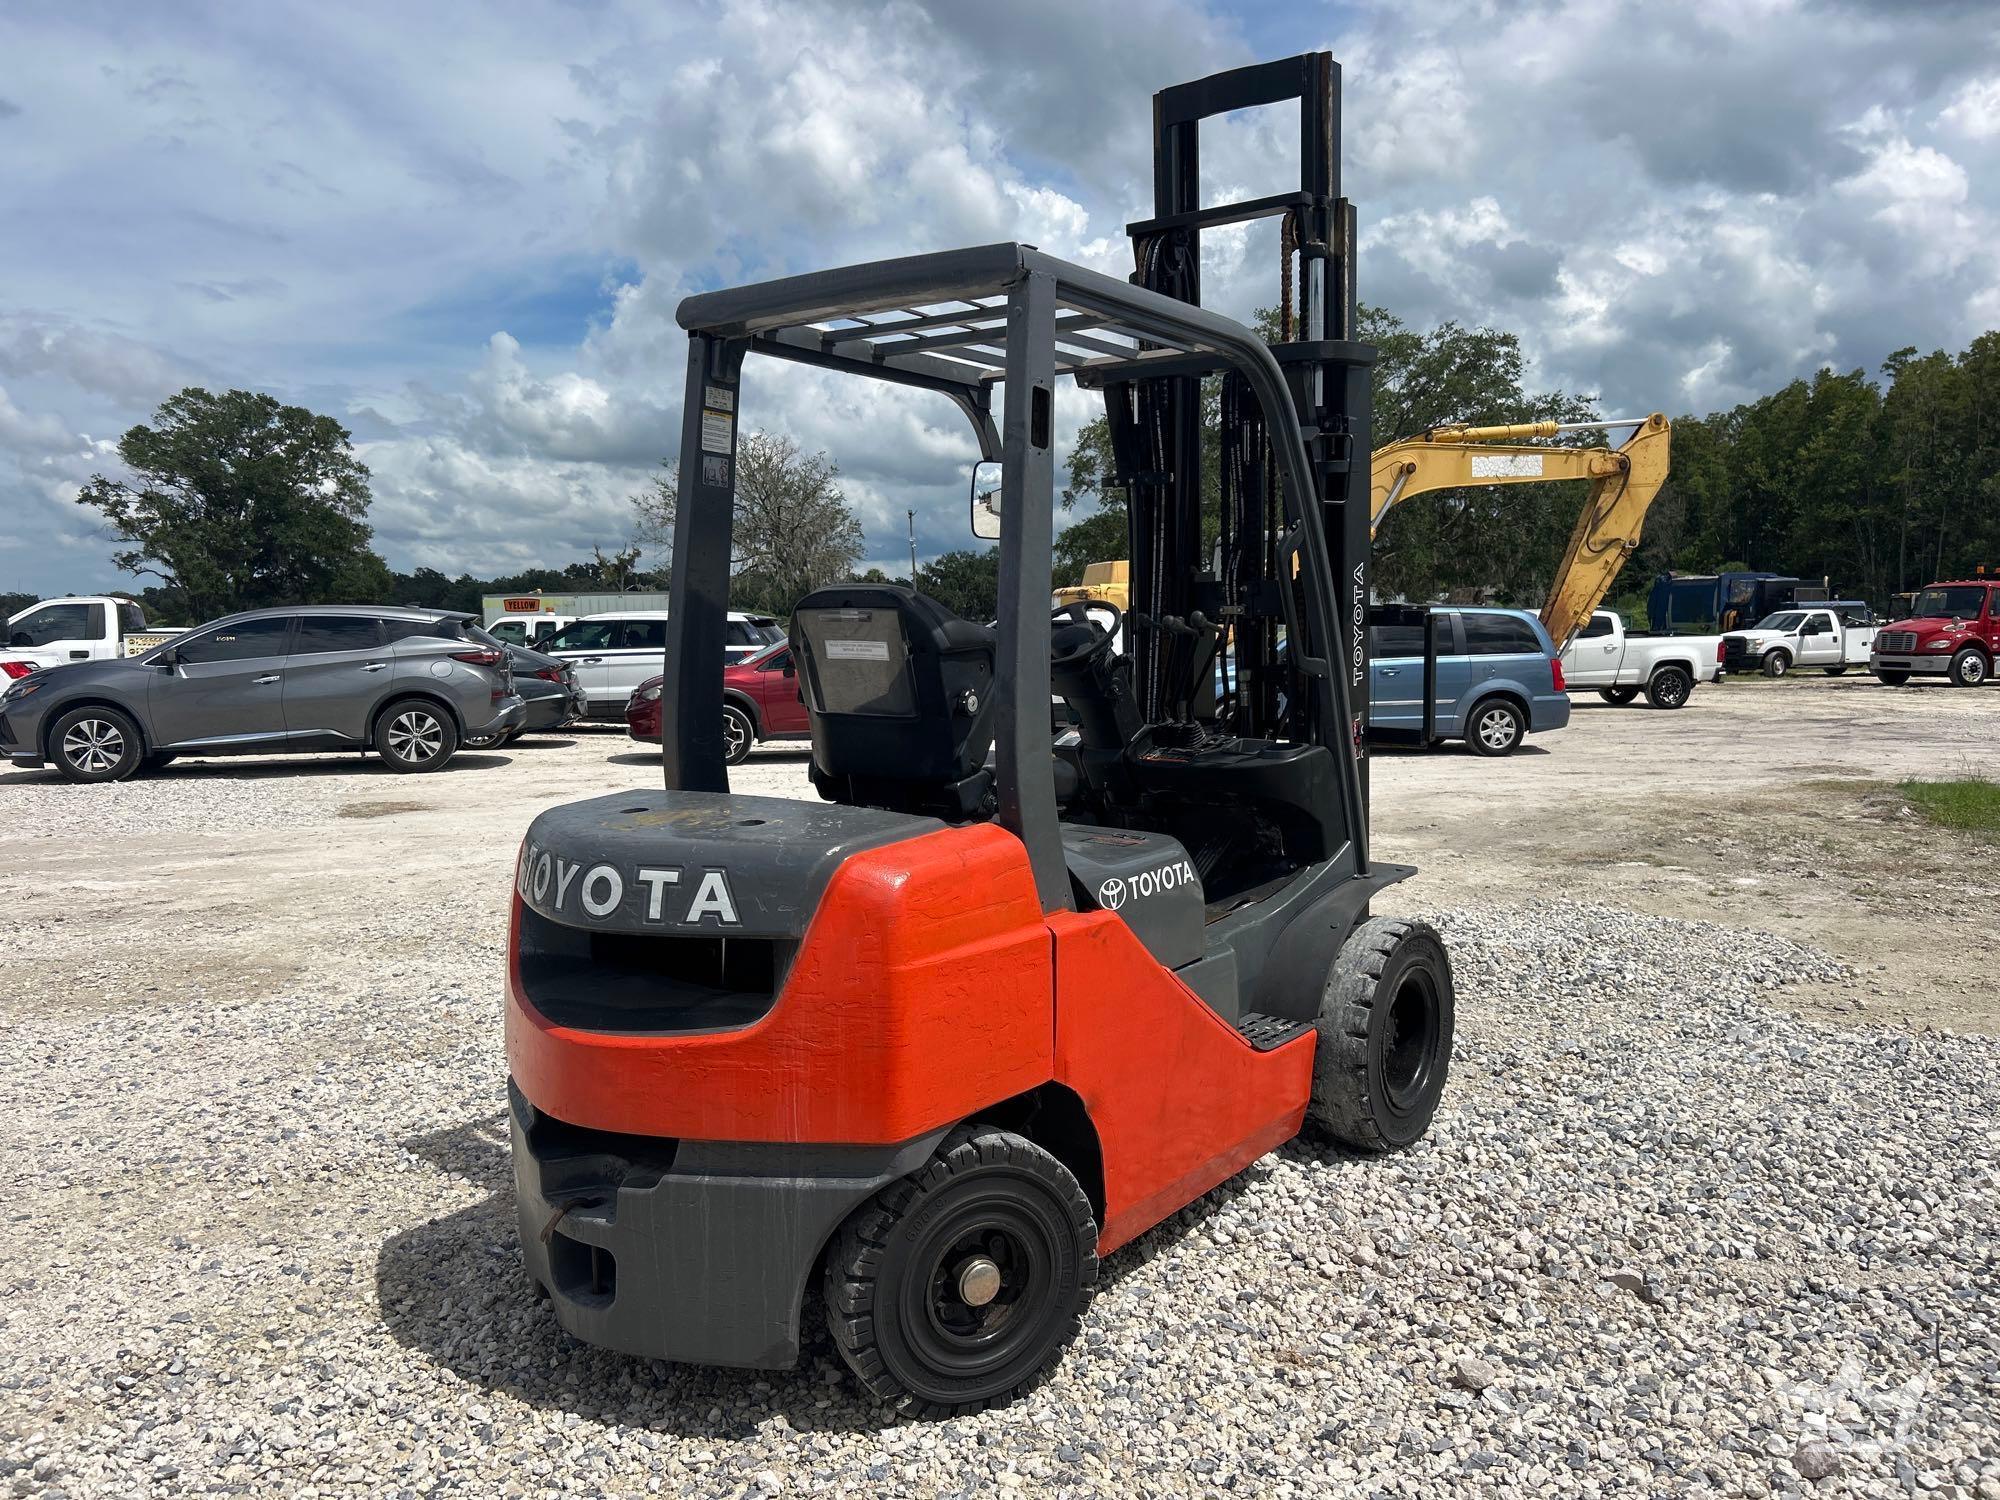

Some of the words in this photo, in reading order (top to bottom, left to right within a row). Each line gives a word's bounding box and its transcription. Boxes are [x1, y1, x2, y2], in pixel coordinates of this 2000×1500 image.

[508, 601, 536, 610] YELLOW
[1353, 561, 1364, 687] TOYOTA
[524, 846, 738, 923] TOYOTA
[1127, 860, 1195, 900] TOYOTA
